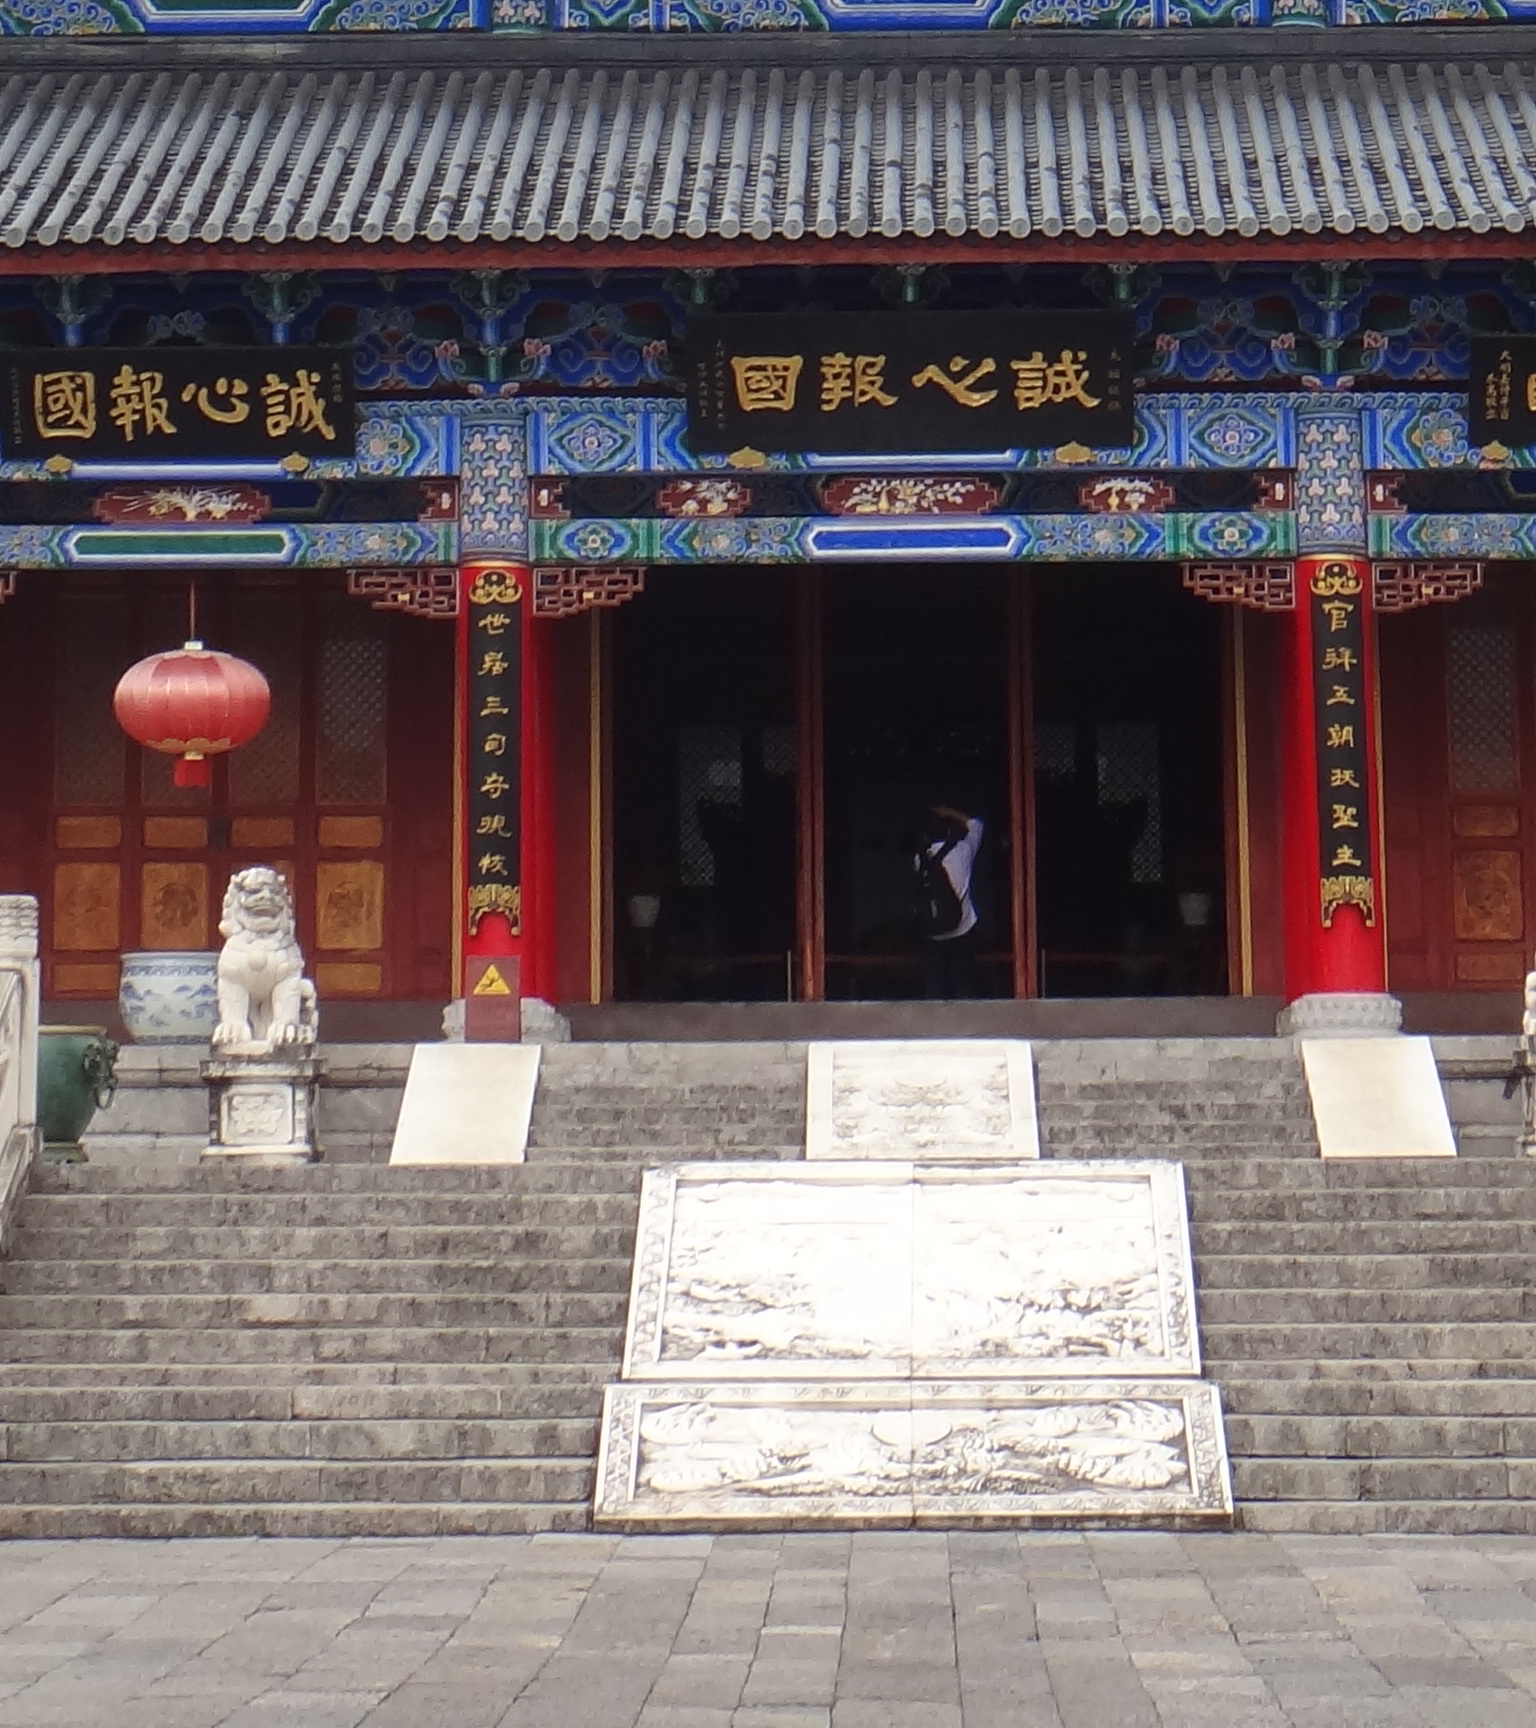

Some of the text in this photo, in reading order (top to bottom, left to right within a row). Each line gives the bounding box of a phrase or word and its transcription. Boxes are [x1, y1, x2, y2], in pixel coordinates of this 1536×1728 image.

[33, 364, 337, 442] 誠心報國
[729, 349, 1101, 412] 誠心報國
